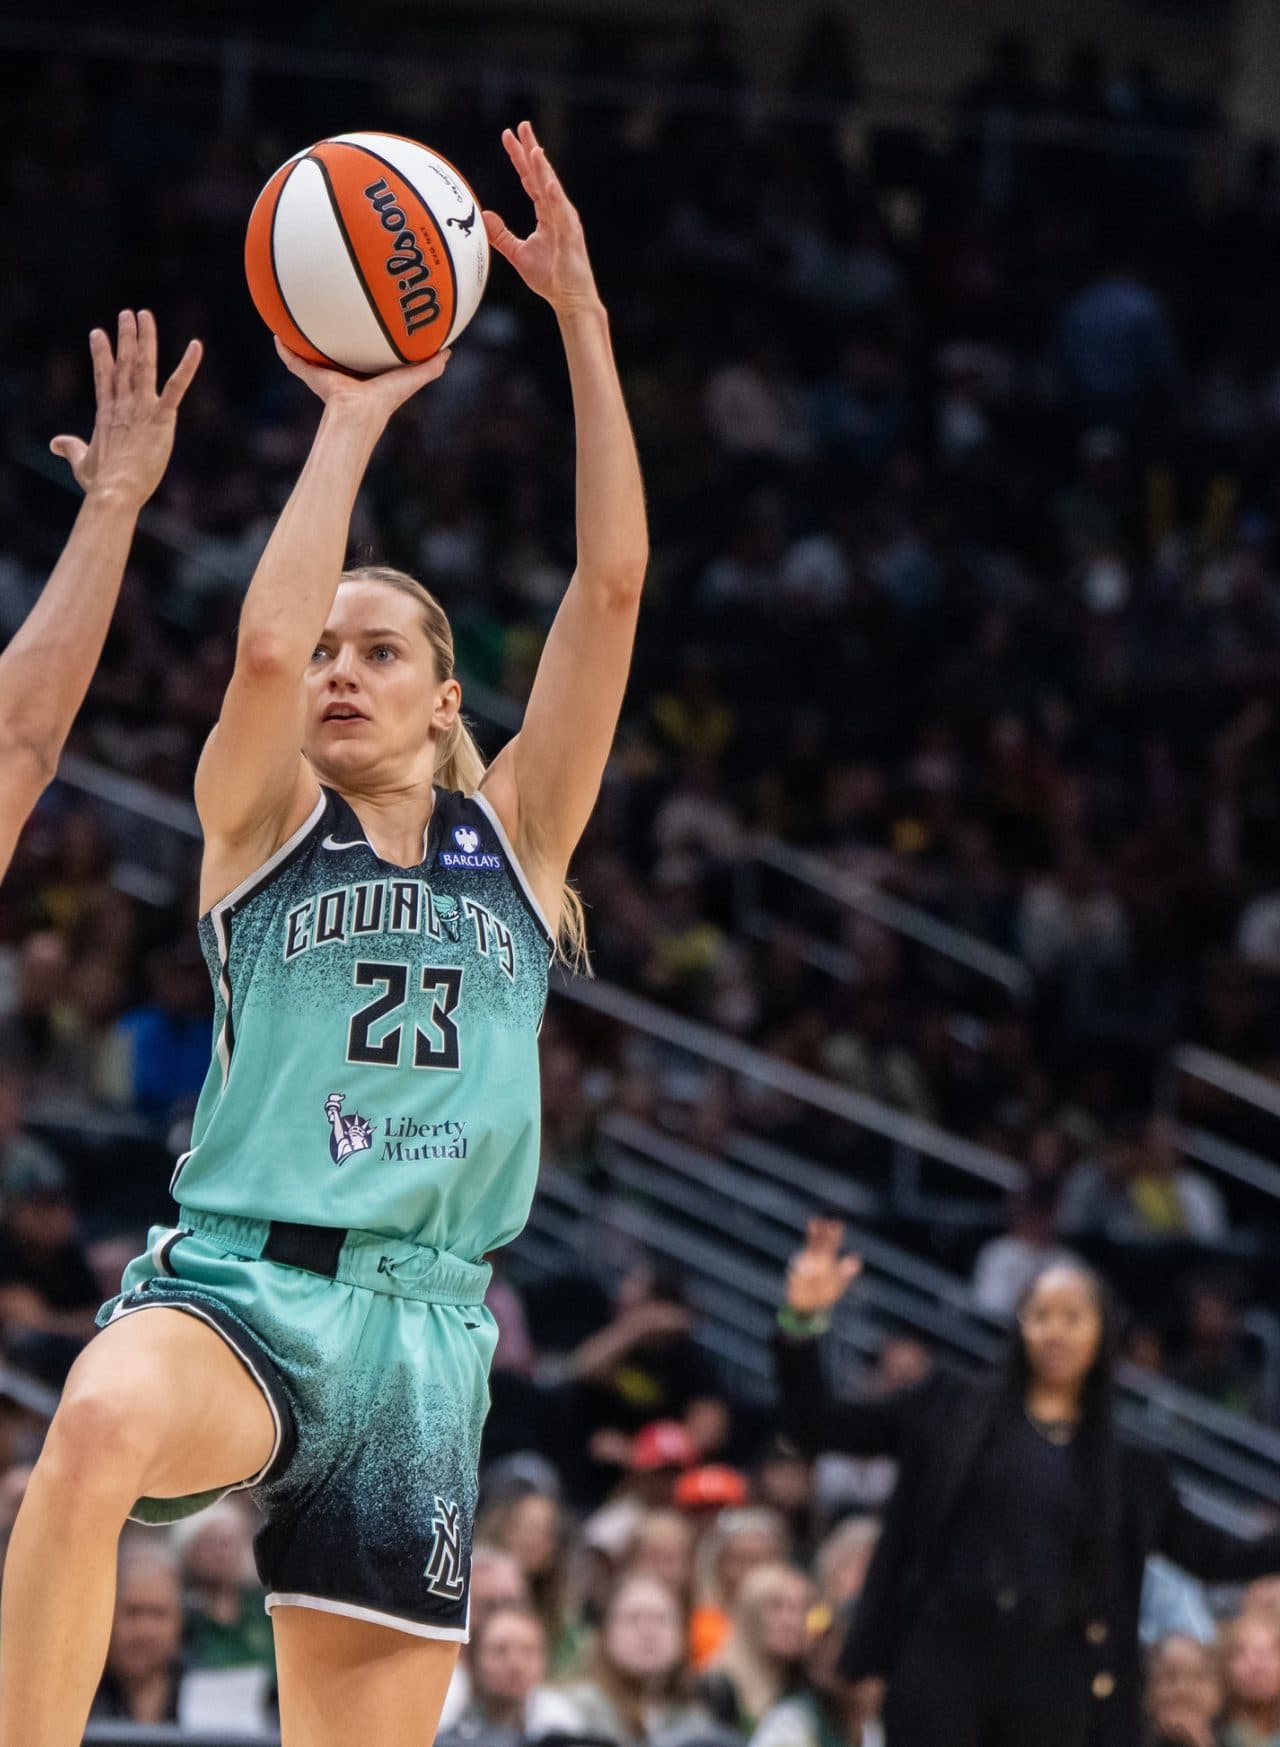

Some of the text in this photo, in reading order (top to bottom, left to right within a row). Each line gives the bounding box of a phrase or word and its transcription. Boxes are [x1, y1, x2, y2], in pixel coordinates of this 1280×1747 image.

[364, 178, 441, 336] Wilson
[443, 853, 501, 869] BARCLAYS
[285, 879, 515, 982] EQUALTY
[345, 960, 464, 1071] 23
[379, 1138, 468, 1162] Mutual
[384, 1117, 468, 1142] Liberty
